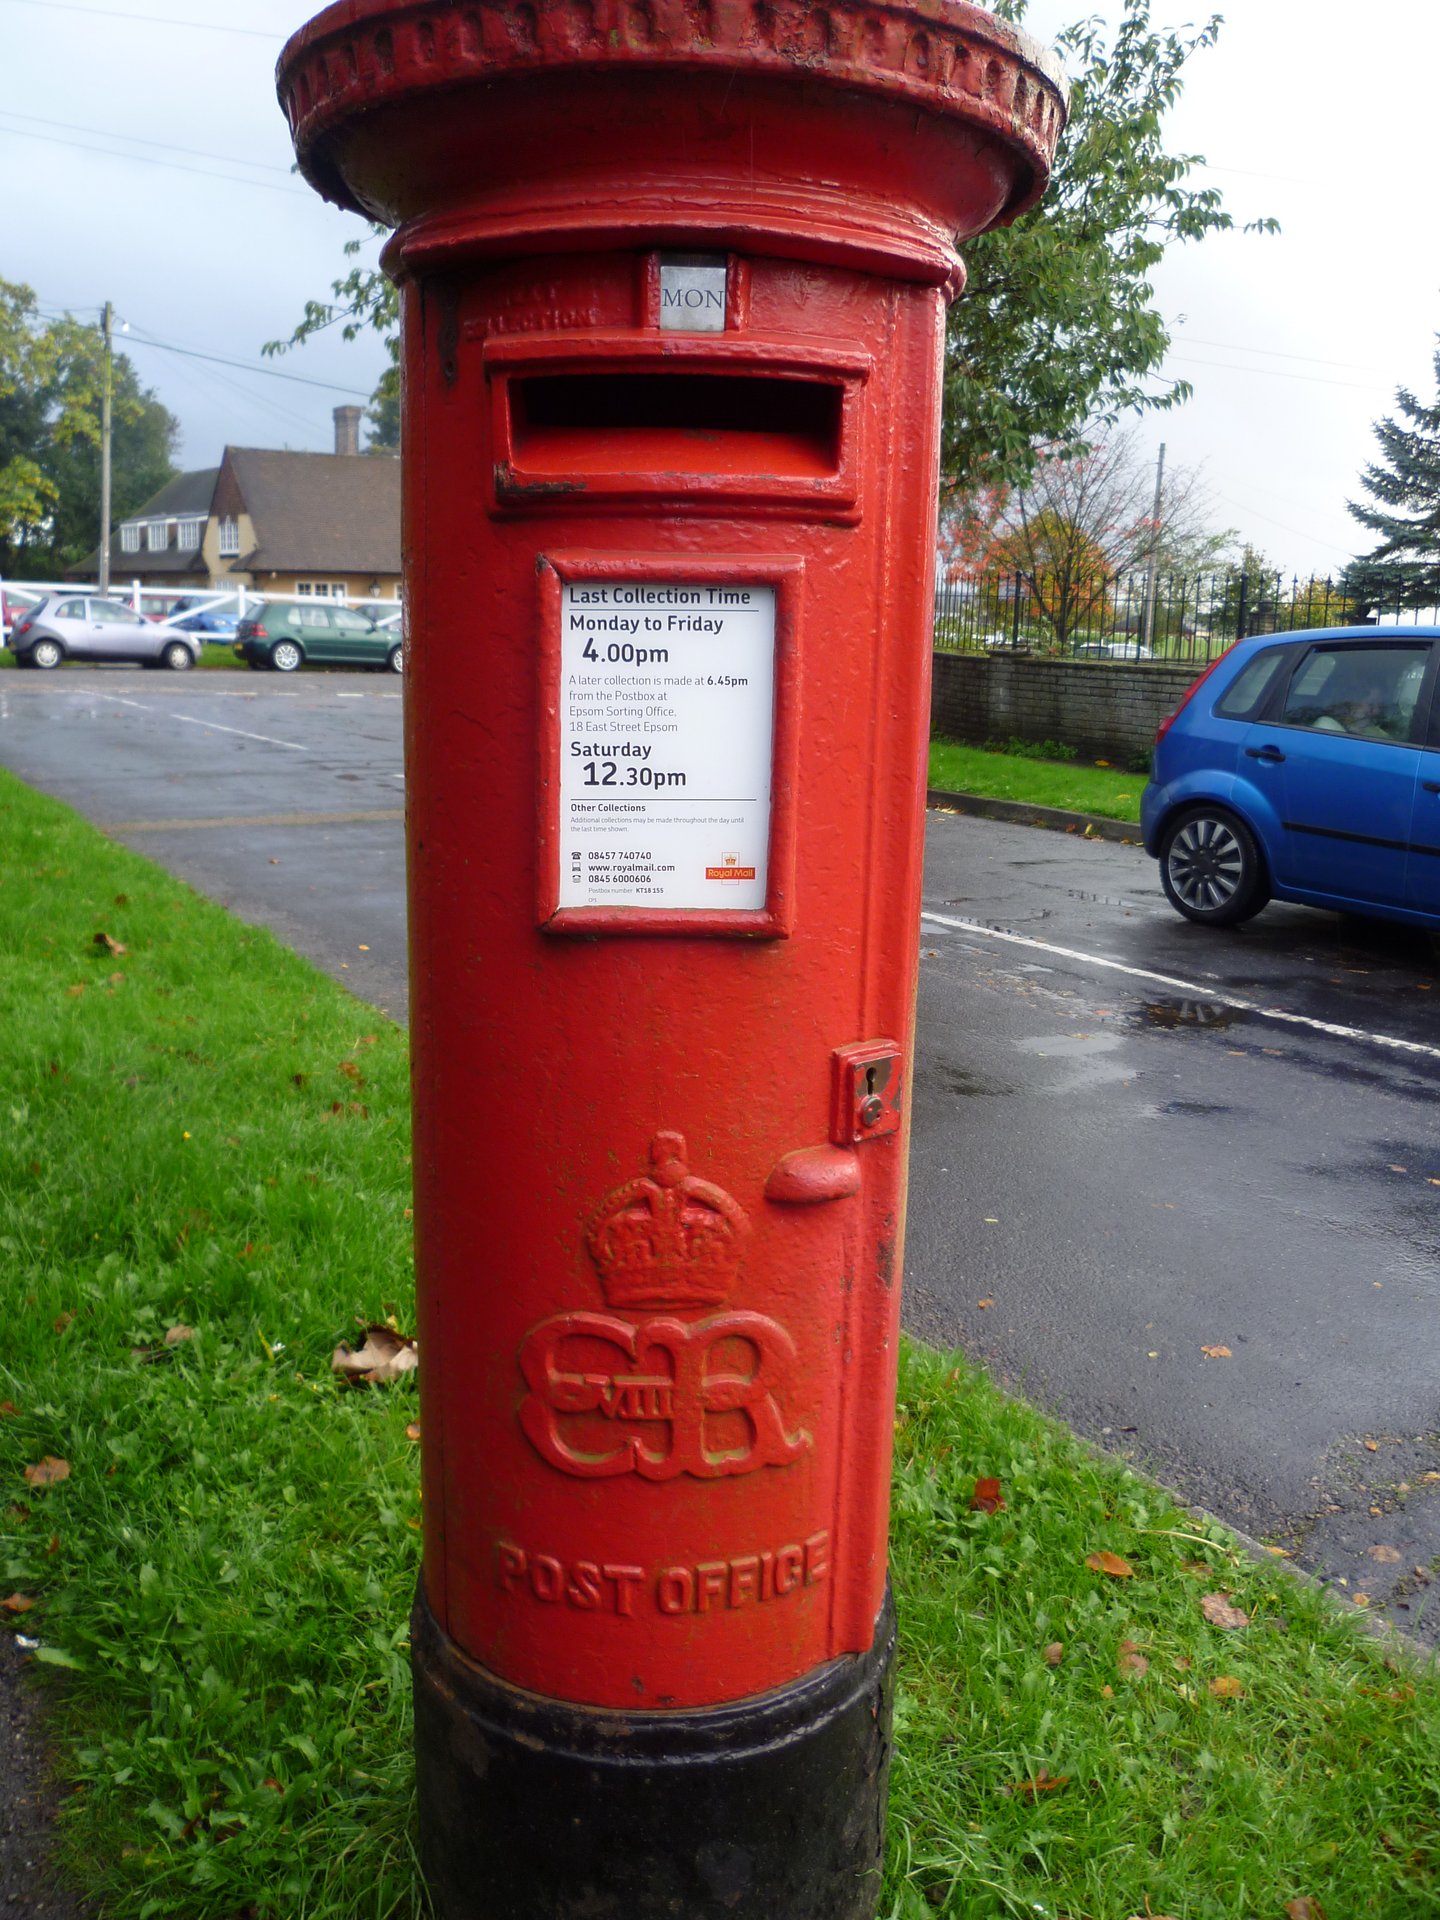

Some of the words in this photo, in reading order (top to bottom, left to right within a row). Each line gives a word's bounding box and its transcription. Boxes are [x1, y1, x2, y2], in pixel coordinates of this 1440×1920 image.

[662, 288, 724, 309] MON
[569, 587, 609, 604] Last
[613, 587, 701, 605] Collection
[706, 588, 751, 605] Time
[570, 615, 640, 634] Monday
[644, 617, 662, 631] to
[668, 615, 724, 635] Friday
[582, 637, 670, 667] 4.00pm
[569, 675, 577, 686] A
[579, 675, 601, 686] later
[604, 675, 651, 686] collection
[653, 675, 662, 686] is
[664, 675, 693, 686] made
[694, 676, 705, 686] at
[707, 675, 748, 688] 6.45pm
[569, 690, 594, 701] from
[597, 691, 613, 701] the
[615, 691, 655, 701] Postbox
[657, 691, 668, 701] at
[569, 706, 604, 718] Epsom
[607, 706, 644, 718] Sorting
[570, 722, 583, 732] 18
[586, 722, 607, 732] East
[610, 722, 641, 732] Street
[644, 722, 678, 733] Epsom
[571, 741, 652, 761] Saturday
[583, 761, 687, 790] 12.30pm
[570, 803, 596, 812] Other
[598, 803, 646, 812] Collections
[570, 816, 600, 824] Additional
[601, 816, 632, 824] collections
[633, 817, 646, 825] may
[656, 816, 672, 824] made
[588, 852, 616, 860] 08457
[618, 852, 652, 860] 740740
[588, 864, 675, 873] www.royalmail.com
[708, 869, 732, 878] Royal
[734, 869, 754, 878] Mail
[588, 875, 610, 883] 0845
[612, 875, 651, 883] 6000606
[499, 1540, 644, 1616] POST
[656, 1529, 829, 1616] OFFICE
